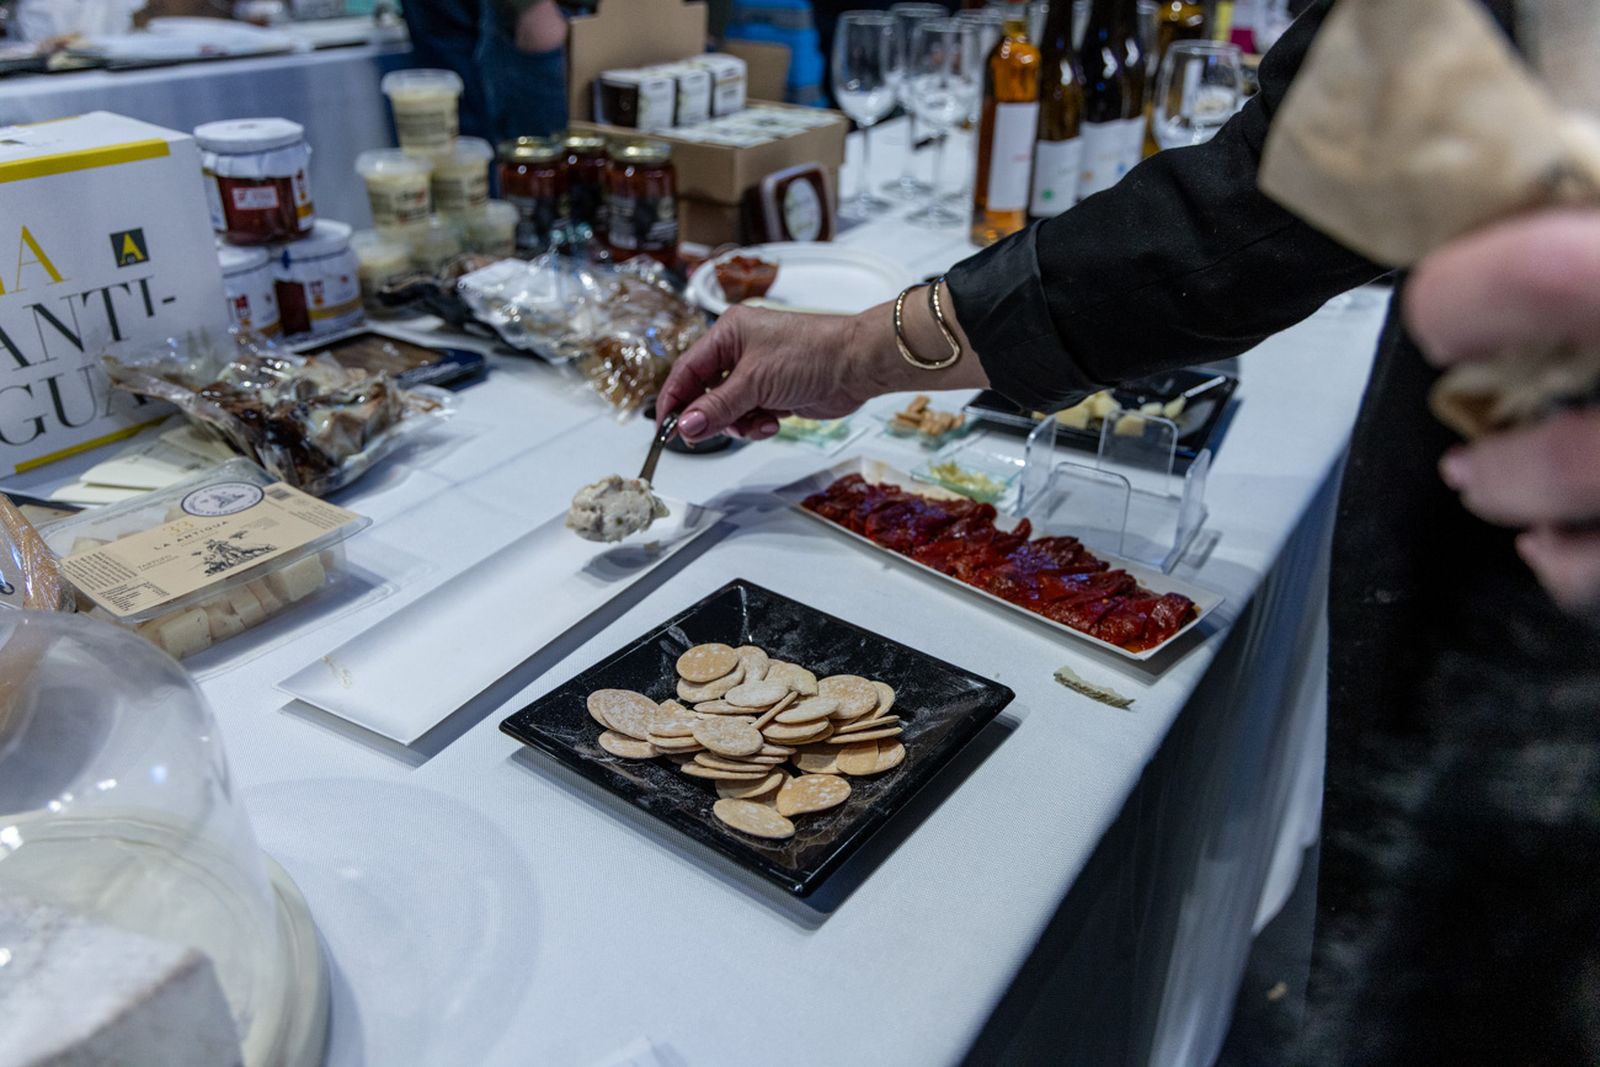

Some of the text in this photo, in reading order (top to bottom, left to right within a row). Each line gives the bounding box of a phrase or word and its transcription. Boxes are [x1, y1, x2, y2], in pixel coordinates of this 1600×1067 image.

[0, 225, 71, 295] A
[119, 232, 145, 265] A
[177, 520, 228, 542] ANTIGUA
